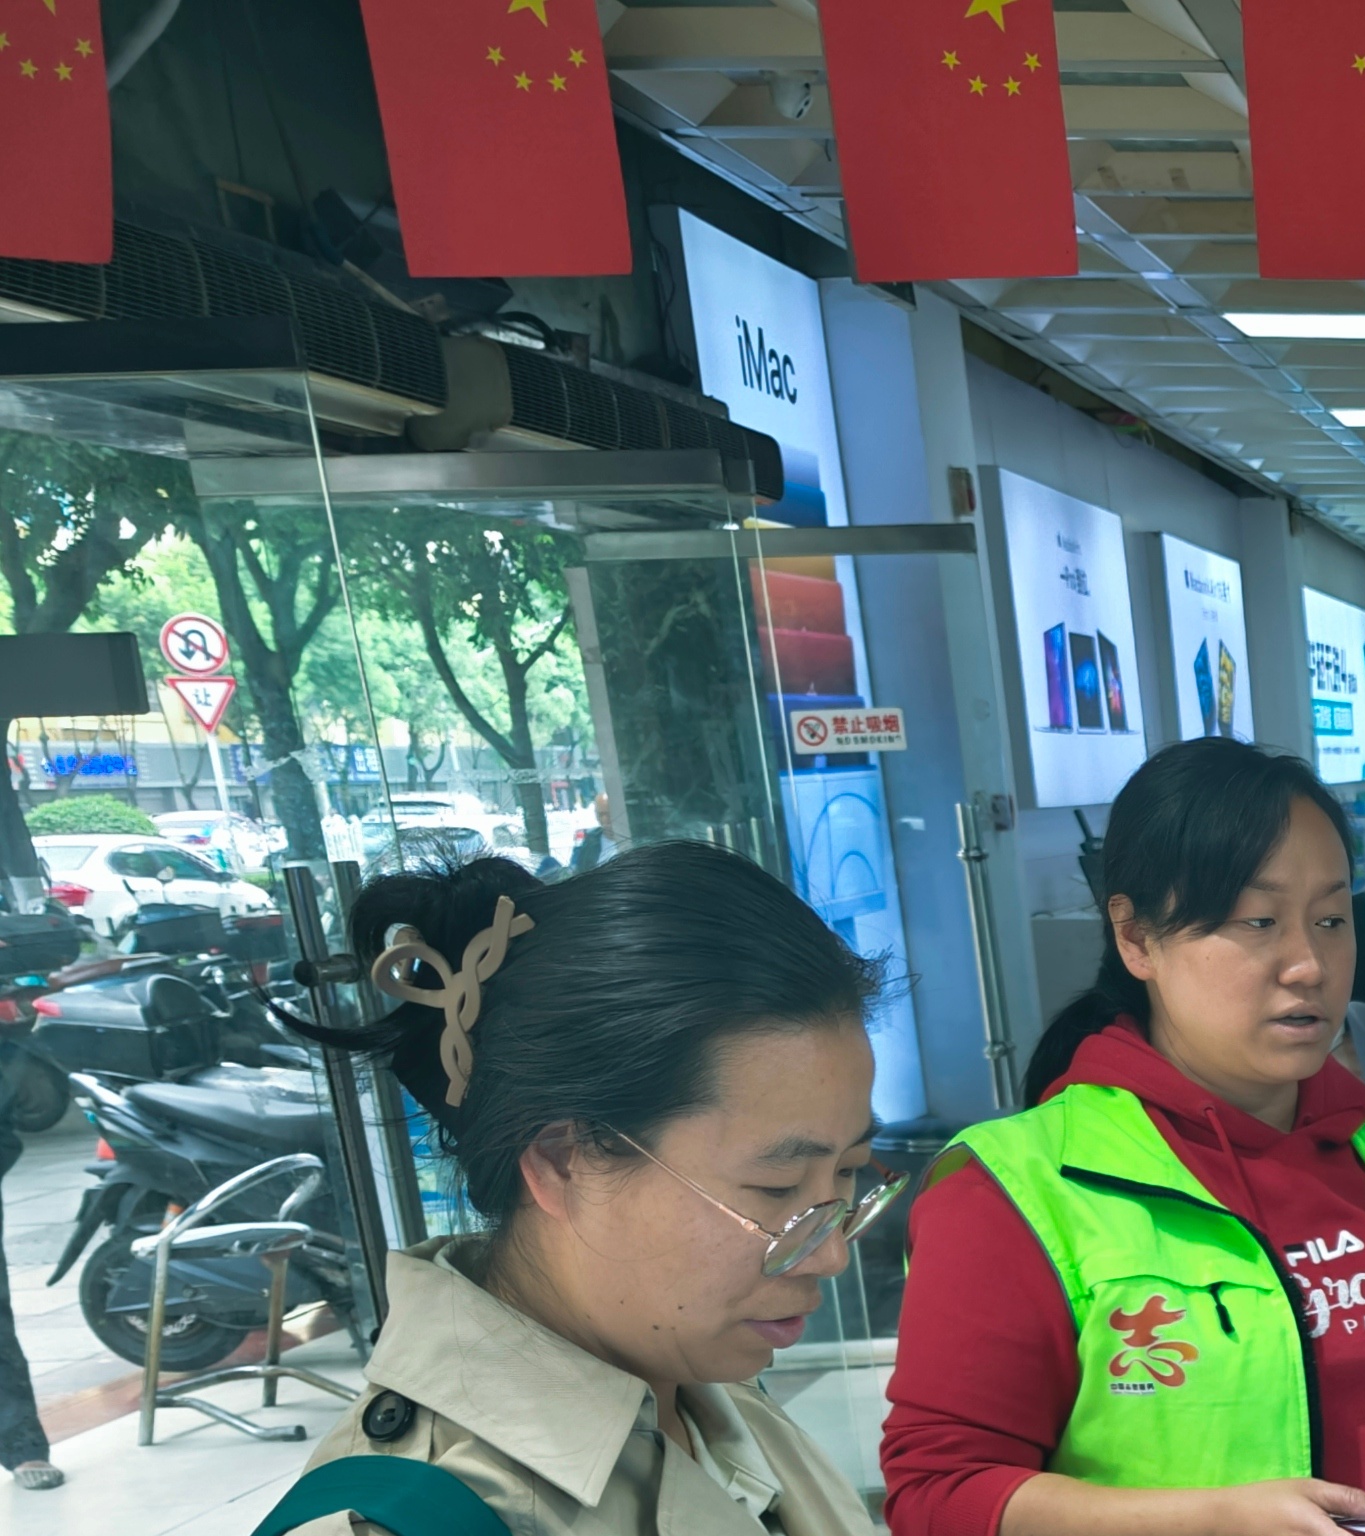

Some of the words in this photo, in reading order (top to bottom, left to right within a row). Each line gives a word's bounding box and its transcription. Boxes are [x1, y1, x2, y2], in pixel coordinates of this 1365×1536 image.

[736, 315, 797, 404] iMac
[192, 688, 213, 707] 让
[832, 714, 900, 735] 禁止吸烟
[1283, 1230, 1365, 1266] FILA
